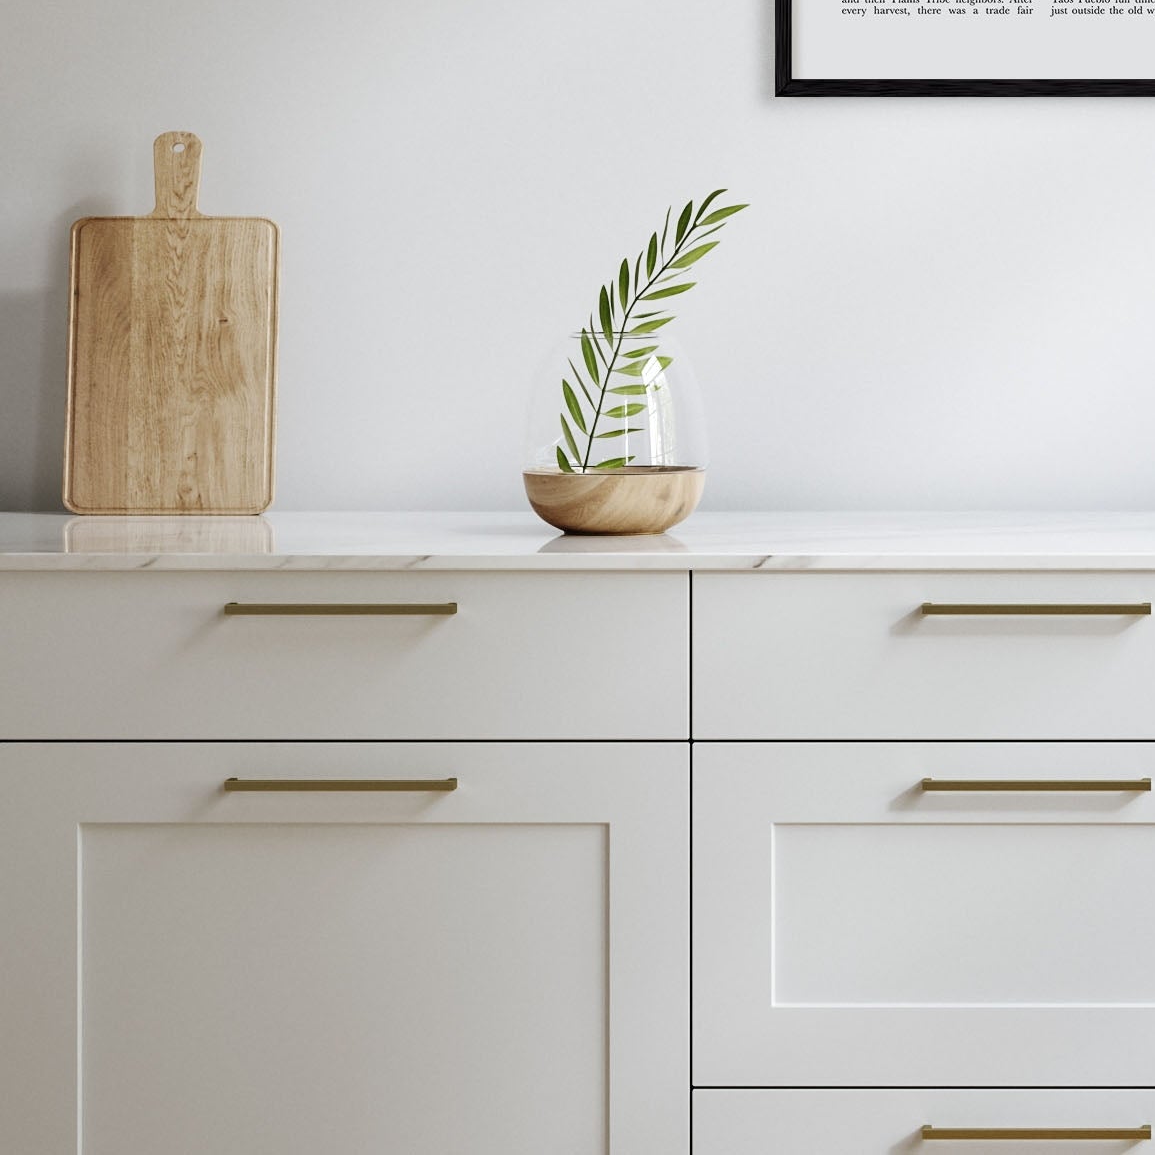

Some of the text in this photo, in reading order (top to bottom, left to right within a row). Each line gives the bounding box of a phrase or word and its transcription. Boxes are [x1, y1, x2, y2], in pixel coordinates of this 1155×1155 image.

[1050, 6, 1068, 16] just
[1071, 6, 1105, 14] outside
[1109, 6, 1124, 14] the
[1127, 6, 1143, 14] old
